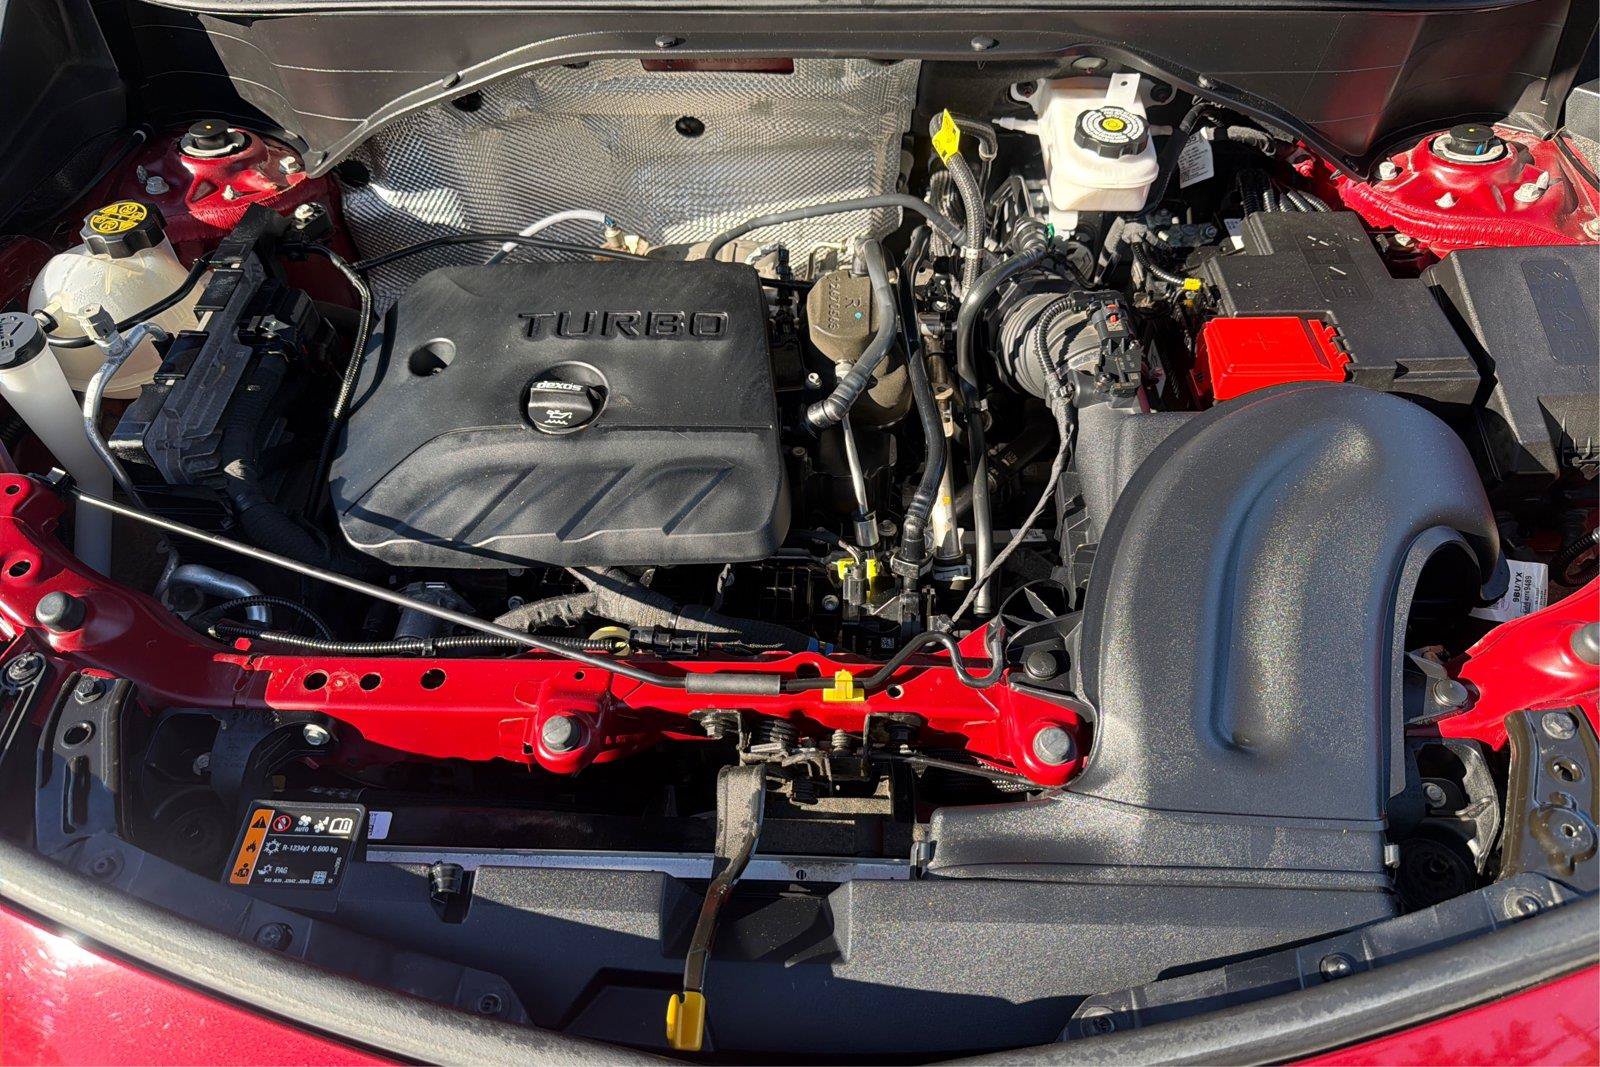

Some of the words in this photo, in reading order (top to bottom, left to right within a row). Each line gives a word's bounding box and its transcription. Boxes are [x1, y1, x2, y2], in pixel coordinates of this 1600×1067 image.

[518, 311, 729, 341] TURBO
[536, 380, 583, 391] dexos
[274, 866, 288, 874] PAG
